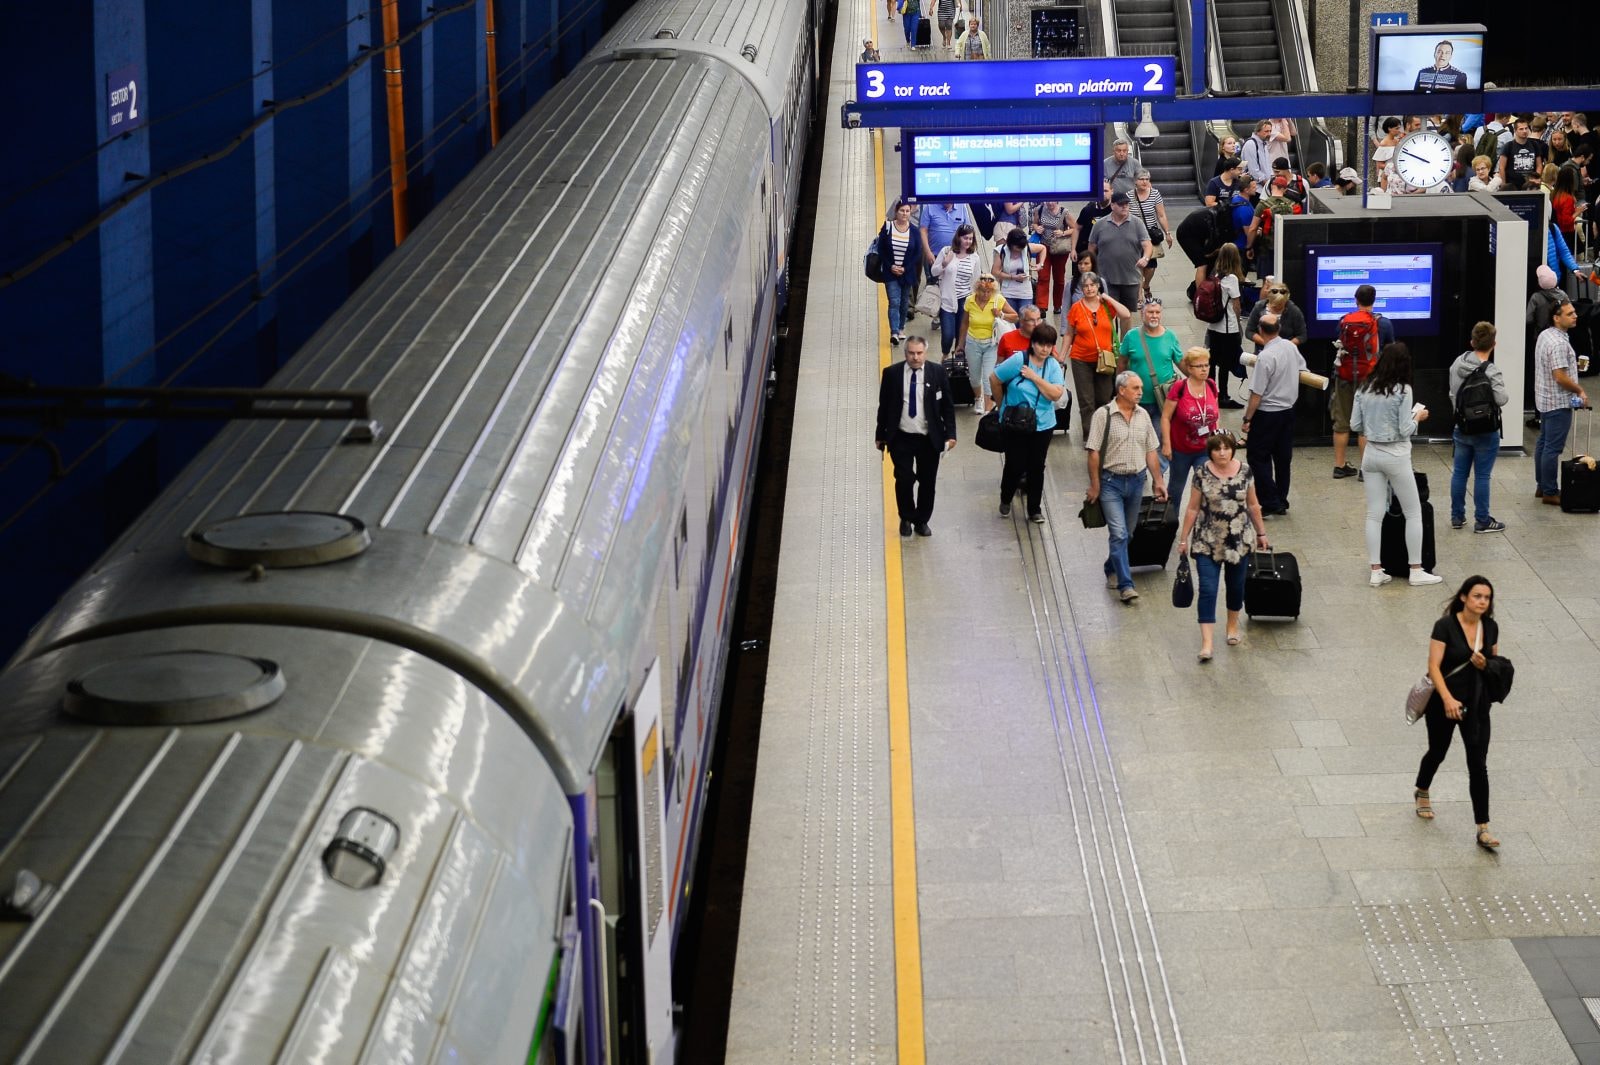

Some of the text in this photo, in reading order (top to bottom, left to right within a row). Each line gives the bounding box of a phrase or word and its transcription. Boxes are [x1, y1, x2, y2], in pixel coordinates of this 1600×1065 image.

[866, 70, 950, 97] 3 tor track
[1035, 63, 1163, 96] peron platform 2
[128, 80, 138, 119] 2
[952, 135, 1003, 149] Warszawa
[1005, 134, 1063, 148] Wschodnia
